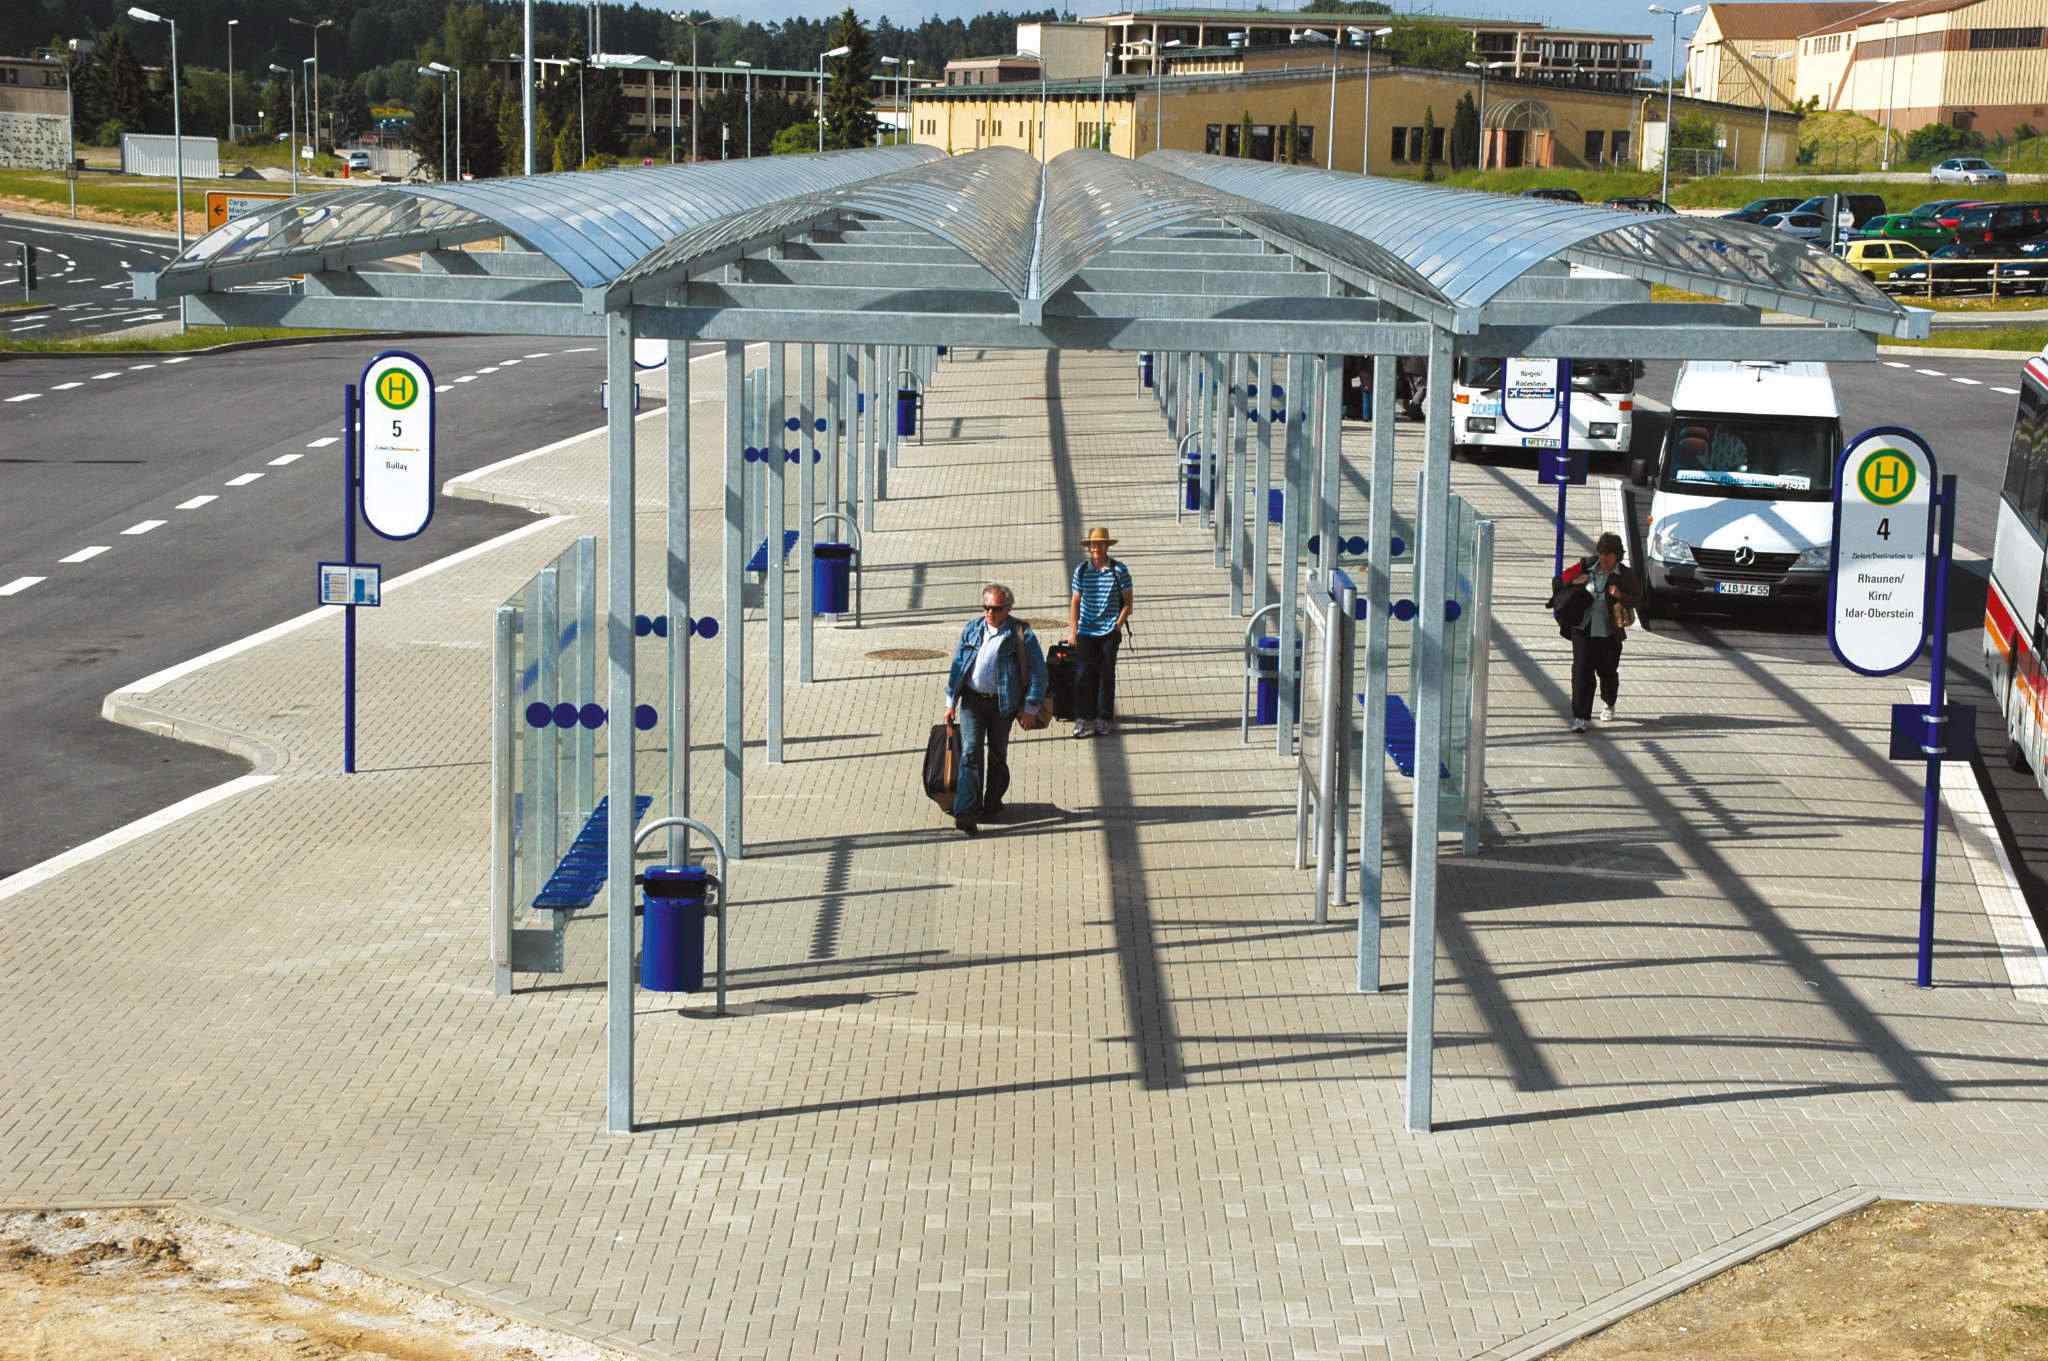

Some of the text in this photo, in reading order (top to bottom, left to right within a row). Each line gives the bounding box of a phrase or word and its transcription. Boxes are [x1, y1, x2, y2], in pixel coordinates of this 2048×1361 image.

[388, 377, 406, 401] H
[392, 420, 402, 438] 5
[1874, 461, 1900, 492] H
[1876, 517, 1891, 541] 4
[1857, 573, 1905, 584] Rhaunen/
[1868, 591, 1892, 601] Kirn/
[1845, 608, 1914, 618] Idar-Oberstein
